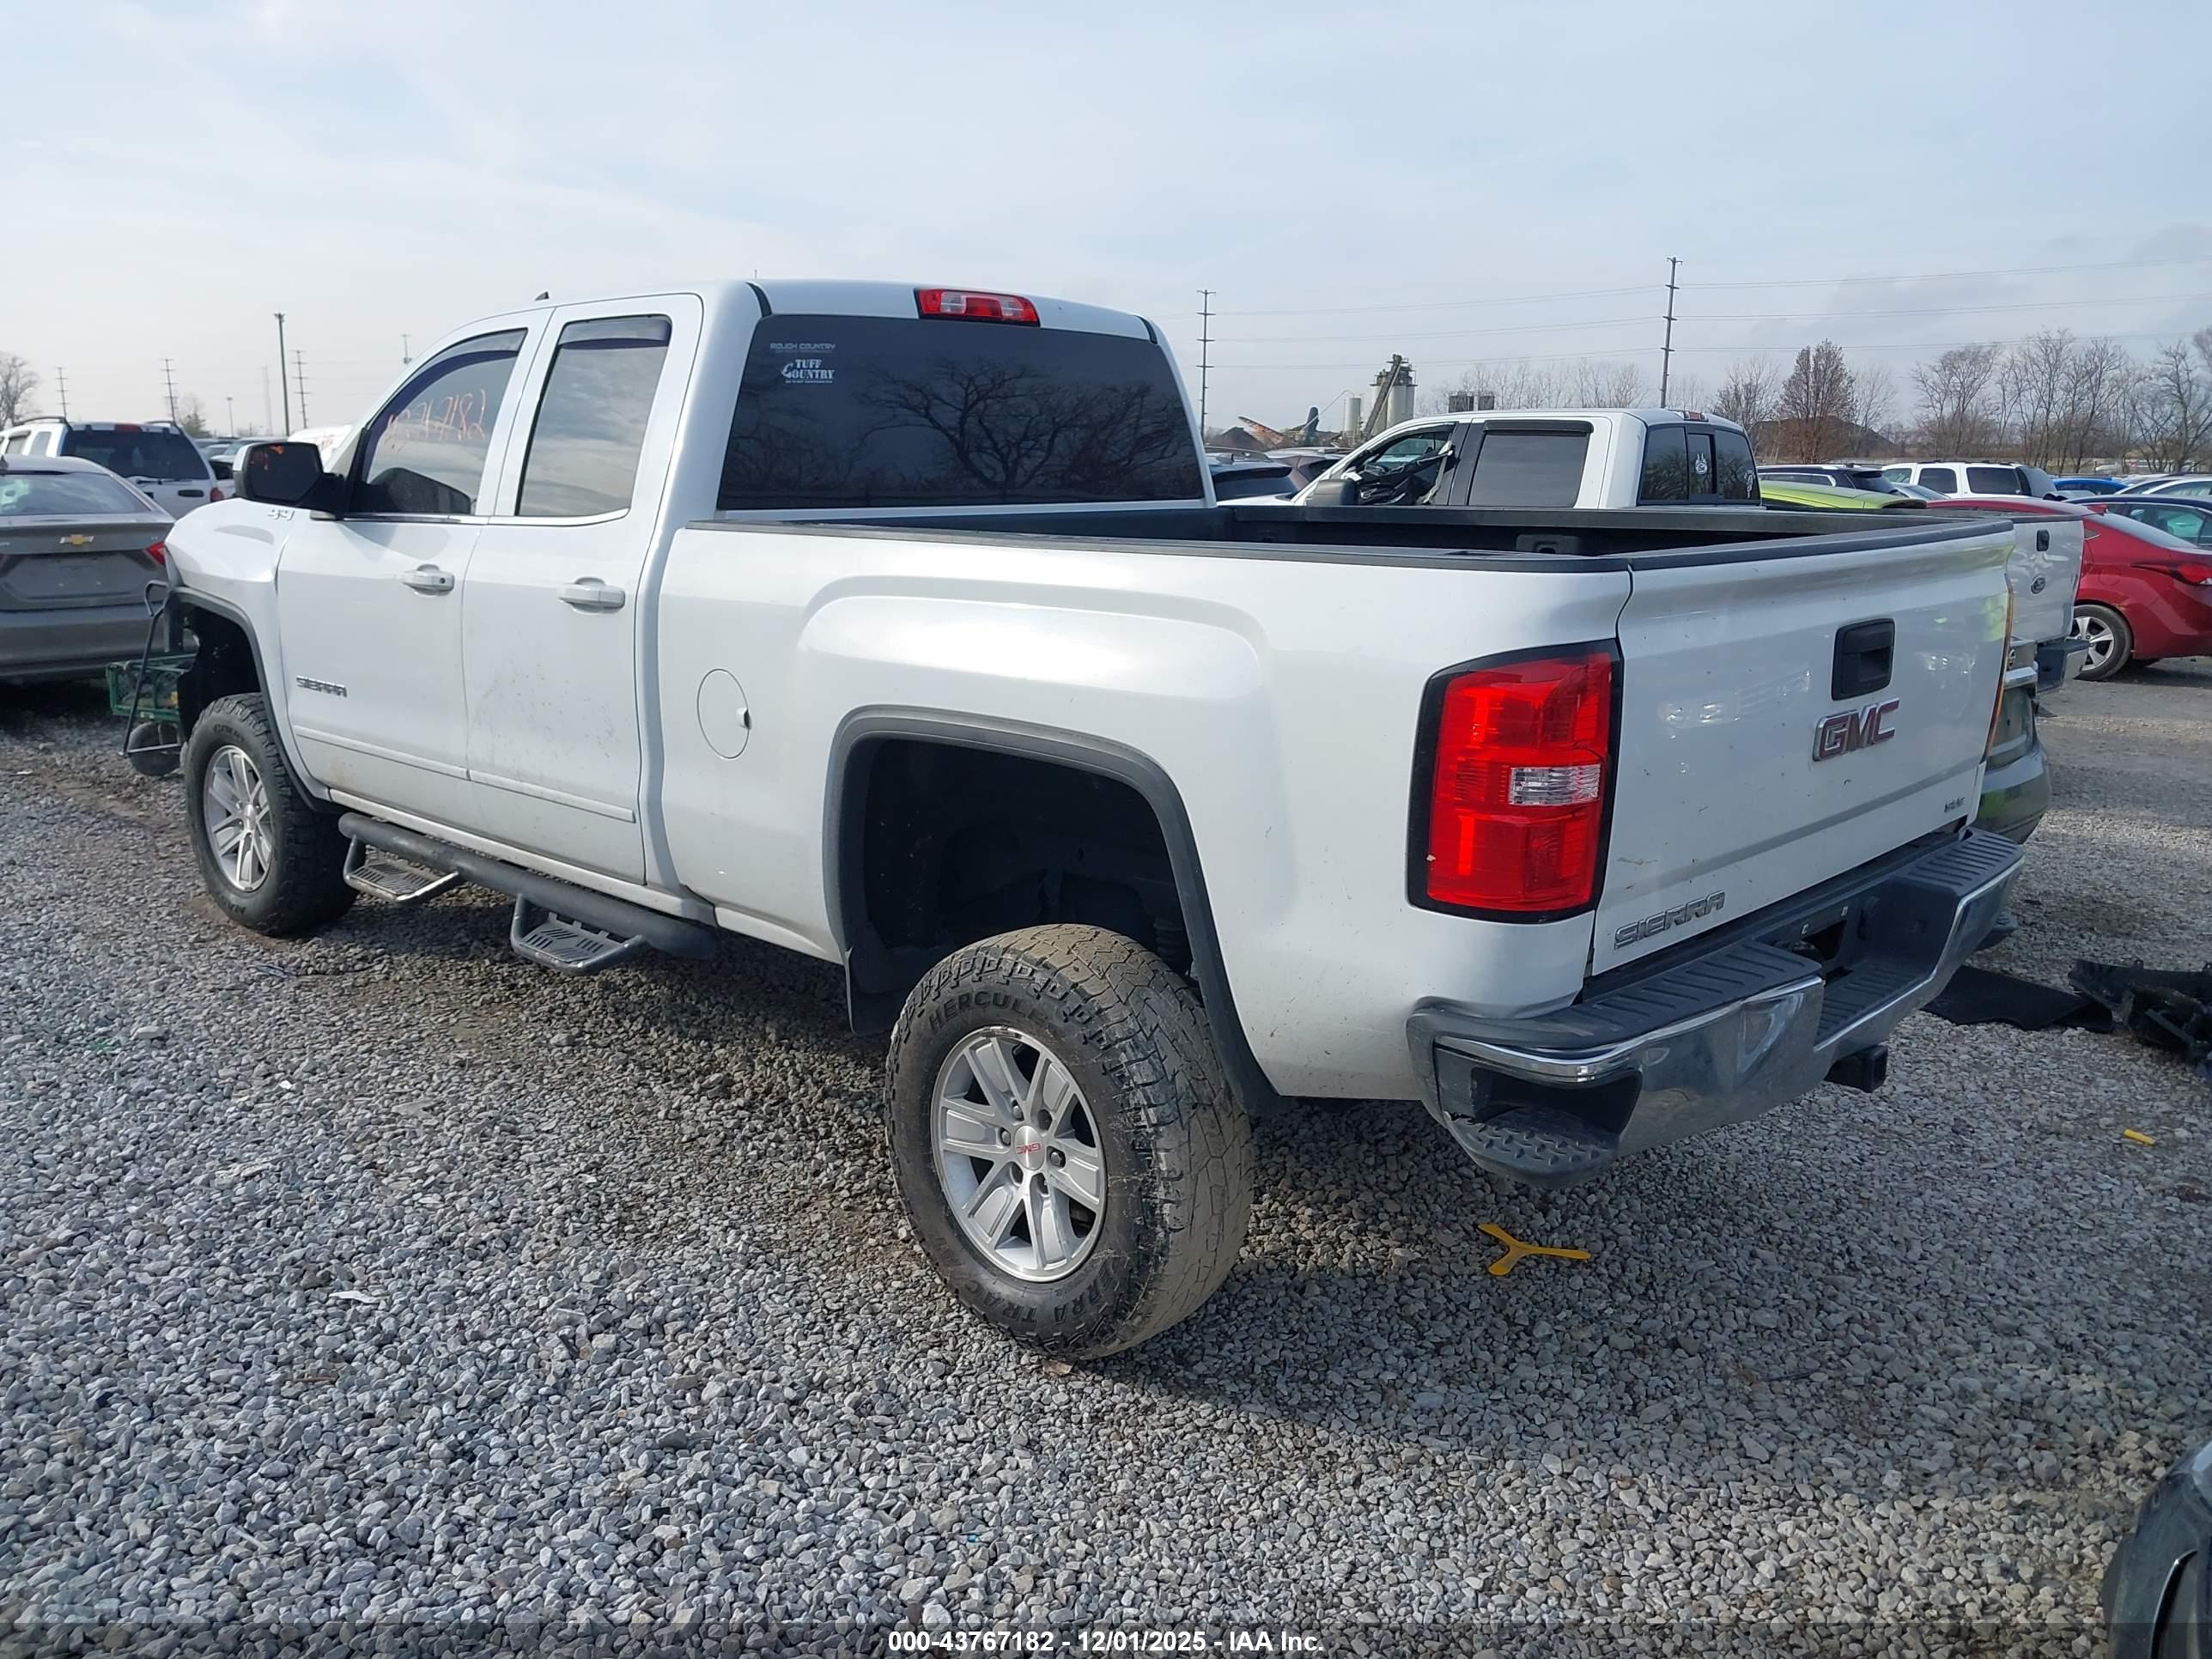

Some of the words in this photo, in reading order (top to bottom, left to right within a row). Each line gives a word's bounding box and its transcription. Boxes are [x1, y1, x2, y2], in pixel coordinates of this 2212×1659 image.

[781, 362, 836, 380] COUNTRY
[795, 358, 823, 369] TUFF
[1813, 697, 1900, 763] GMC
[1613, 890, 1726, 951] SIERRA
[1015, 1141, 1042, 1155] GMC
